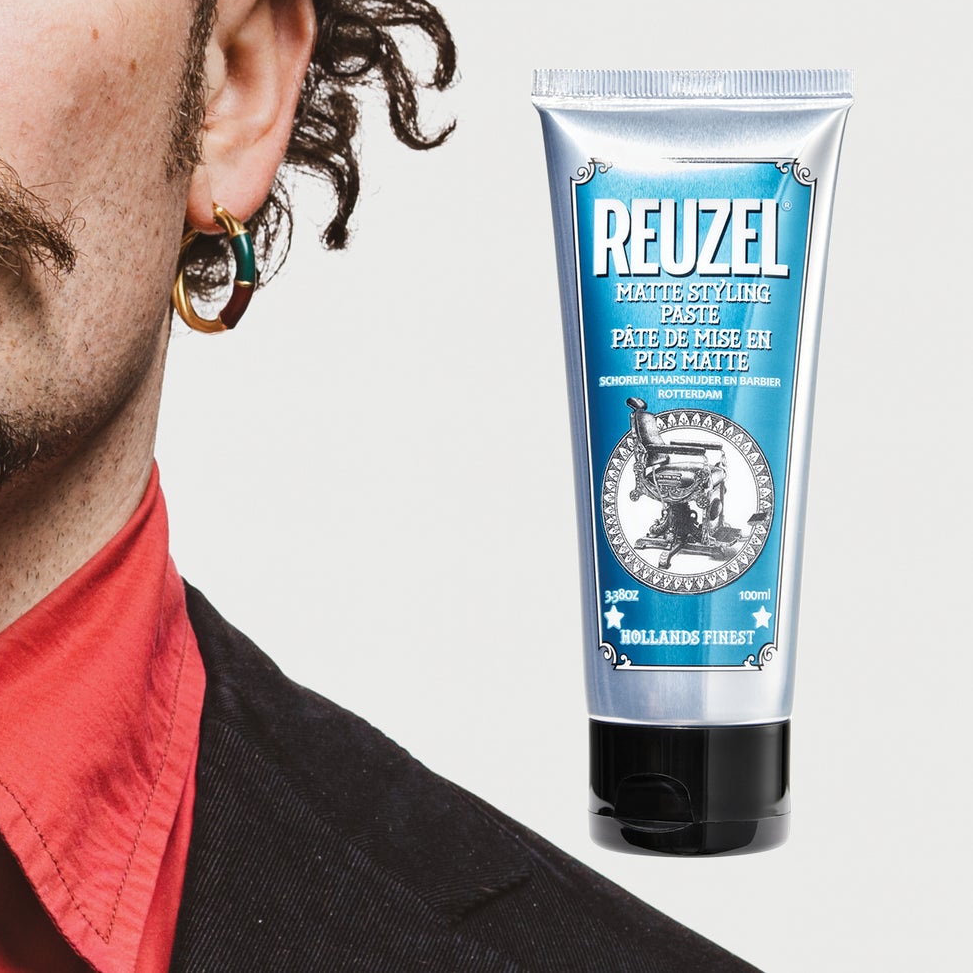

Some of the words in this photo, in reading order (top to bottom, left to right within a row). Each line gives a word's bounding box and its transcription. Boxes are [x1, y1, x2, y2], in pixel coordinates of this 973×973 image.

[615, 282, 683, 303] MATTE
[687, 279, 771, 304] STYLING
[660, 305, 720, 325] PASTE
[610, 324, 660, 349] PÂTE
[664, 328, 689, 349] DE
[693, 328, 742, 349] MISE
[746, 330, 772, 350] EN
[634, 350, 677, 371] PLIS
[680, 350, 749, 372] MATTE
[599, 375, 648, 387] SCHOREM
[723, 376, 737, 386] EN
[739, 376, 781, 387] BARBIER
[658, 389, 723, 400] ROTTERDAM
[739, 588, 771, 601] 100ml
[619, 628, 700, 645] HOLLANDS
[702, 630, 756, 645] FINEST
